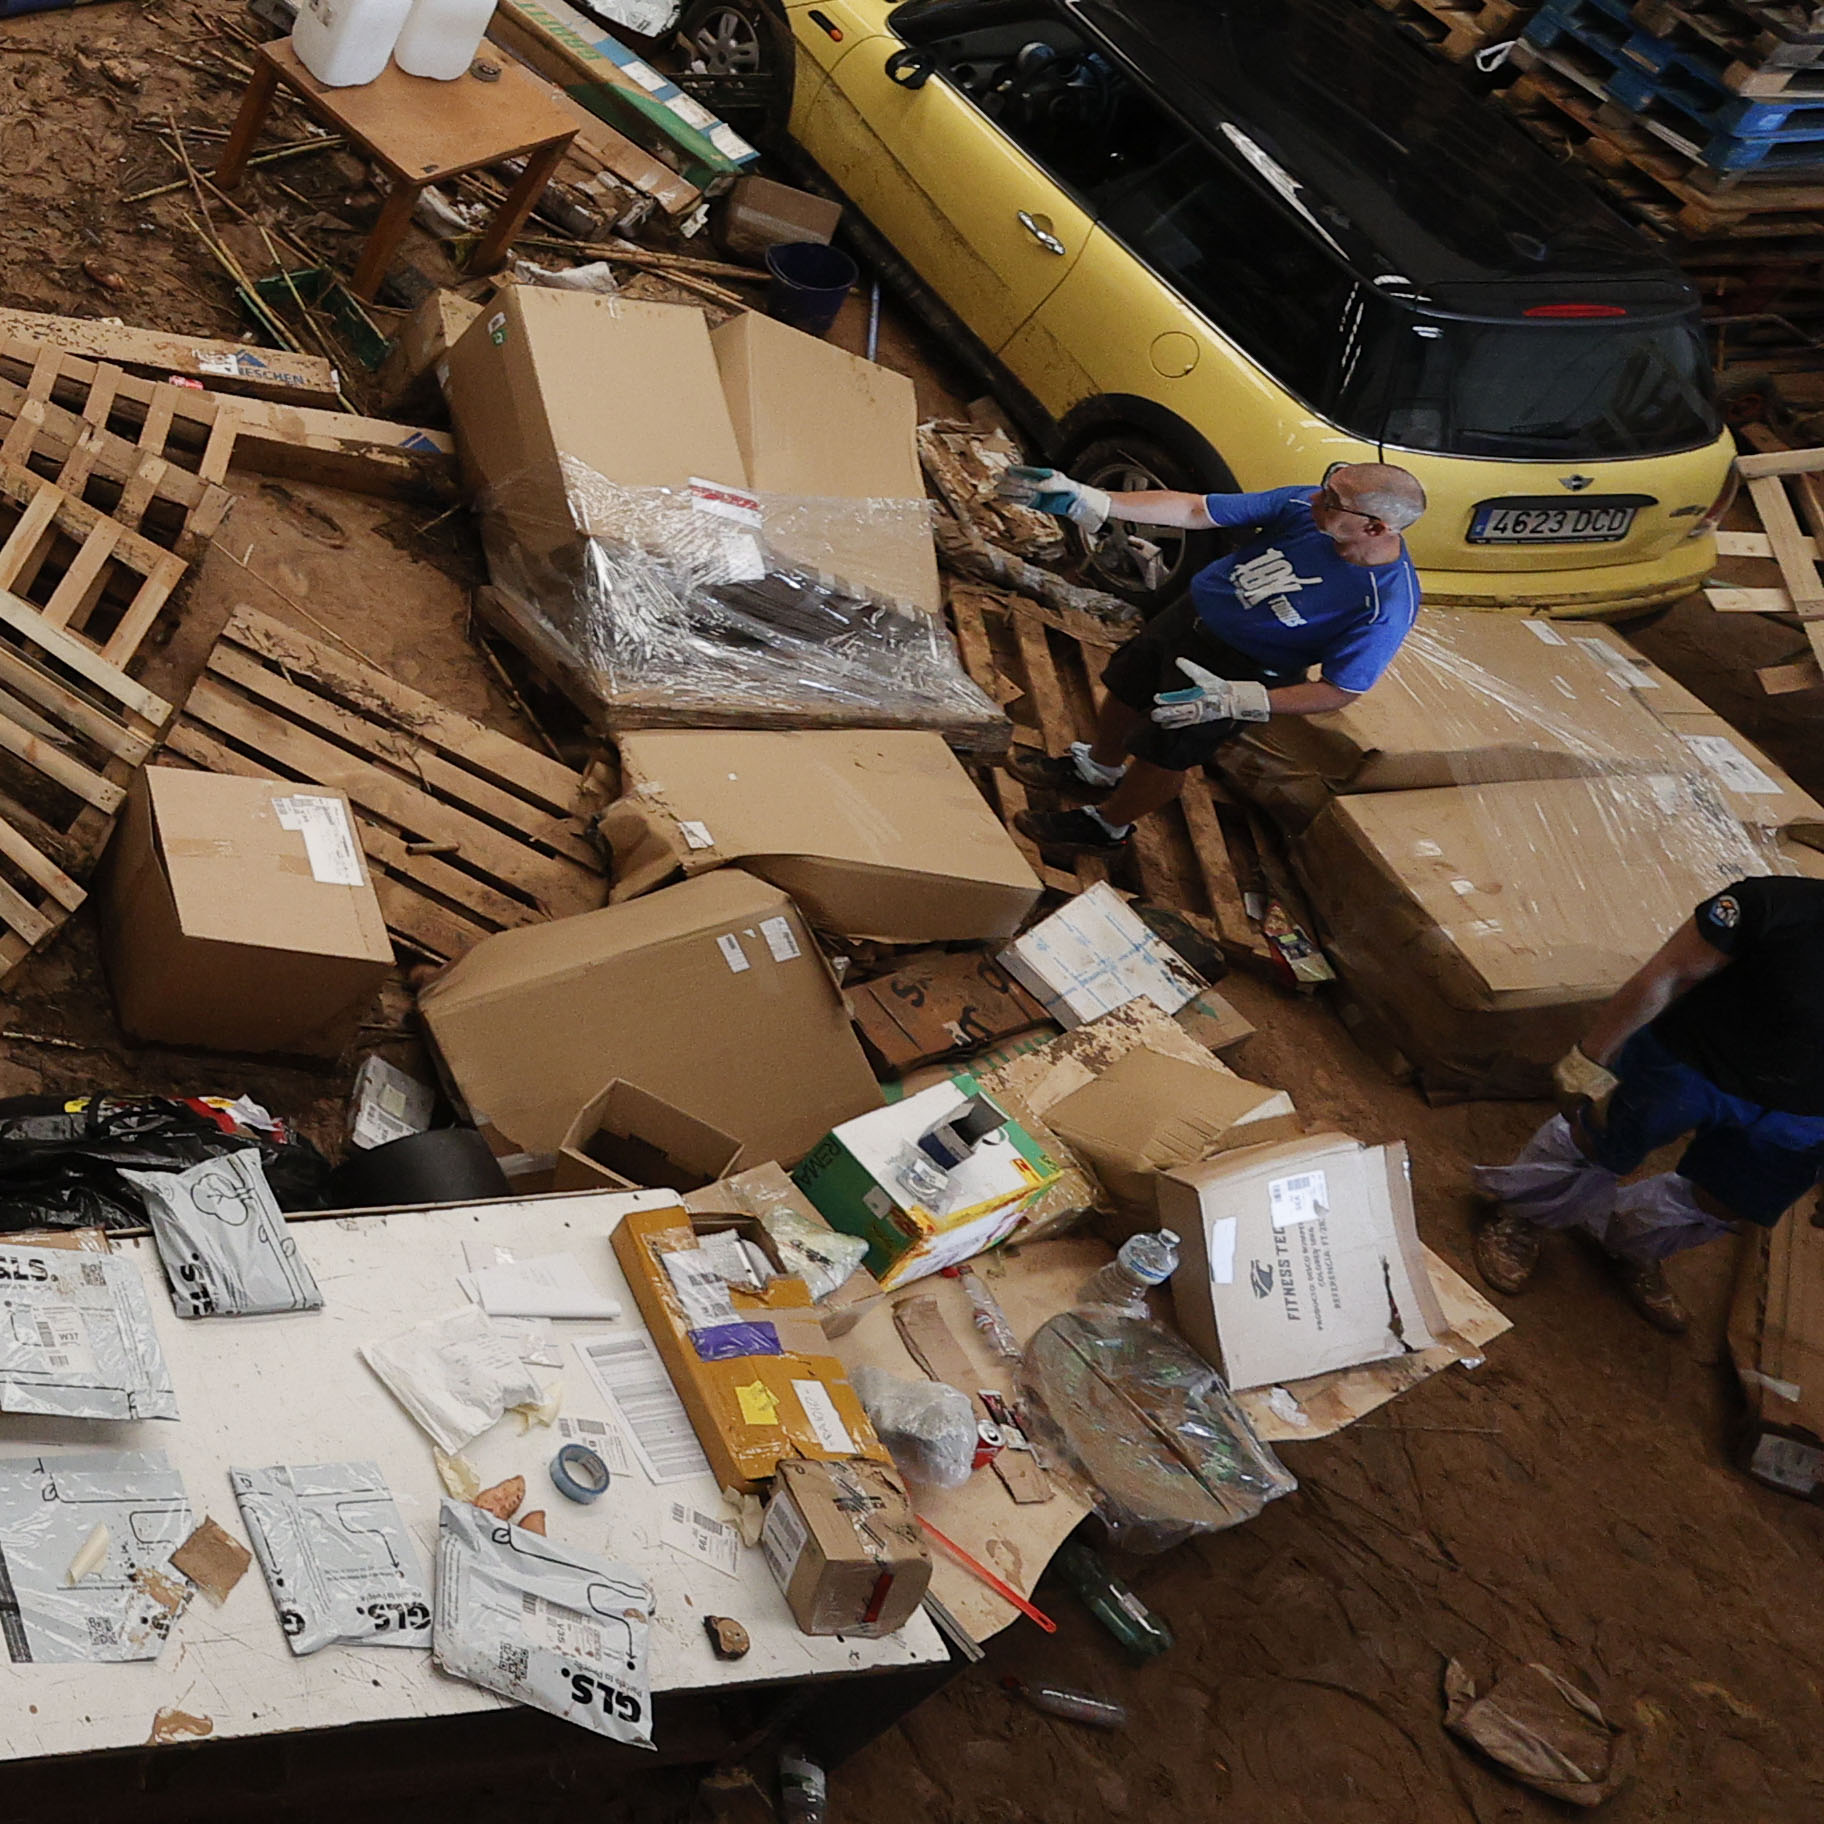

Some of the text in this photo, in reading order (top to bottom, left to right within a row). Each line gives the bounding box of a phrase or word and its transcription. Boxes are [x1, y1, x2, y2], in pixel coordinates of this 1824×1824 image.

[1492, 508, 1628, 534] 4623 DCD
[1277, 1259, 1300, 1321] FITNESS
[356, 1602, 432, 1631] GLS.
[560, 1667, 641, 1724] GLS.
